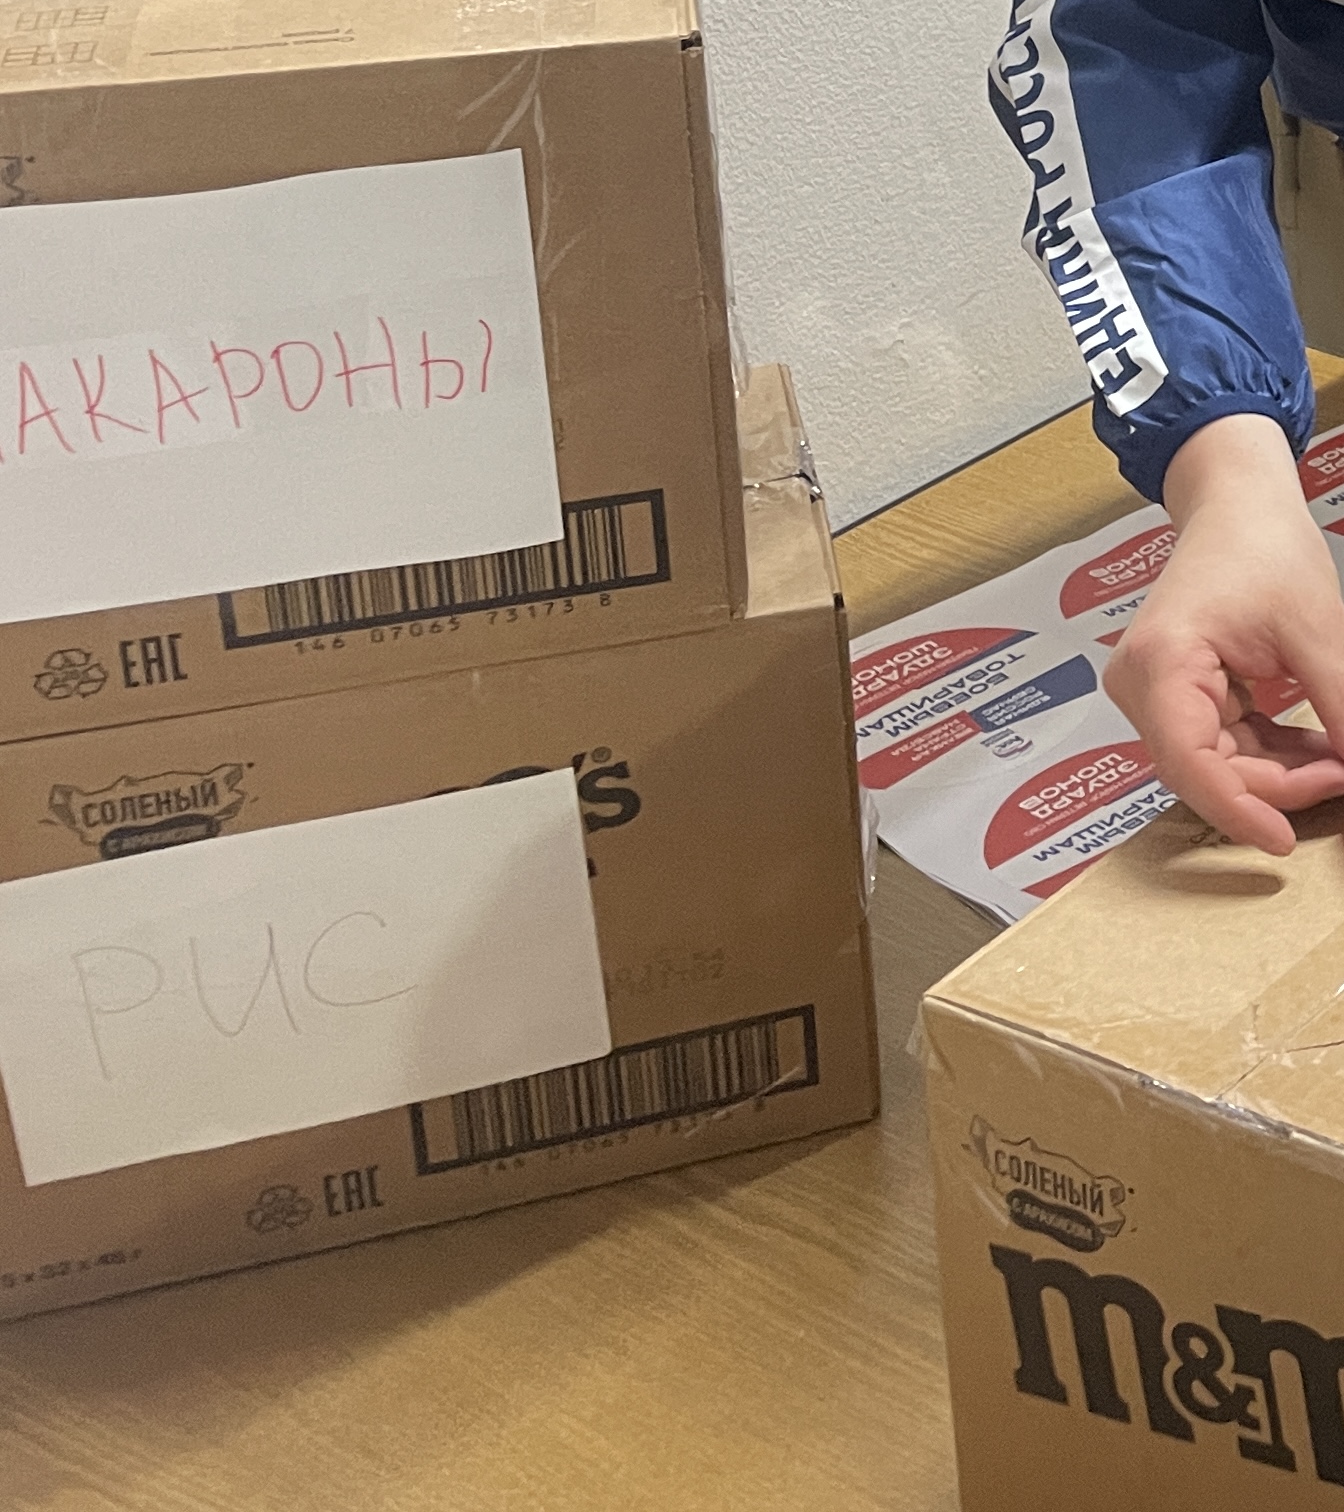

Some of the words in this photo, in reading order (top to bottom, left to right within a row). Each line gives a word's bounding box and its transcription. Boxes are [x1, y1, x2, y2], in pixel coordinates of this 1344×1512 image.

[0, 316, 494, 464] АКАРОНЫ
[1100, 544, 1175, 585] ДУАРД
[485, 598, 577, 626] 73173
[600, 593, 612, 608] 8
[851, 640, 938, 686] ШОНО
[884, 672, 1009, 737] БОЕВЫМ
[81, 777, 219, 828] СОЛЕНЫЙ
[1018, 753, 1123, 810] ШОНОВ
[1031, 760, 1139, 819] ЭДУАРД
[72, 911, 418, 1083] РИС
[995, 1149, 1103, 1217] СОЛЕНЫЙ
